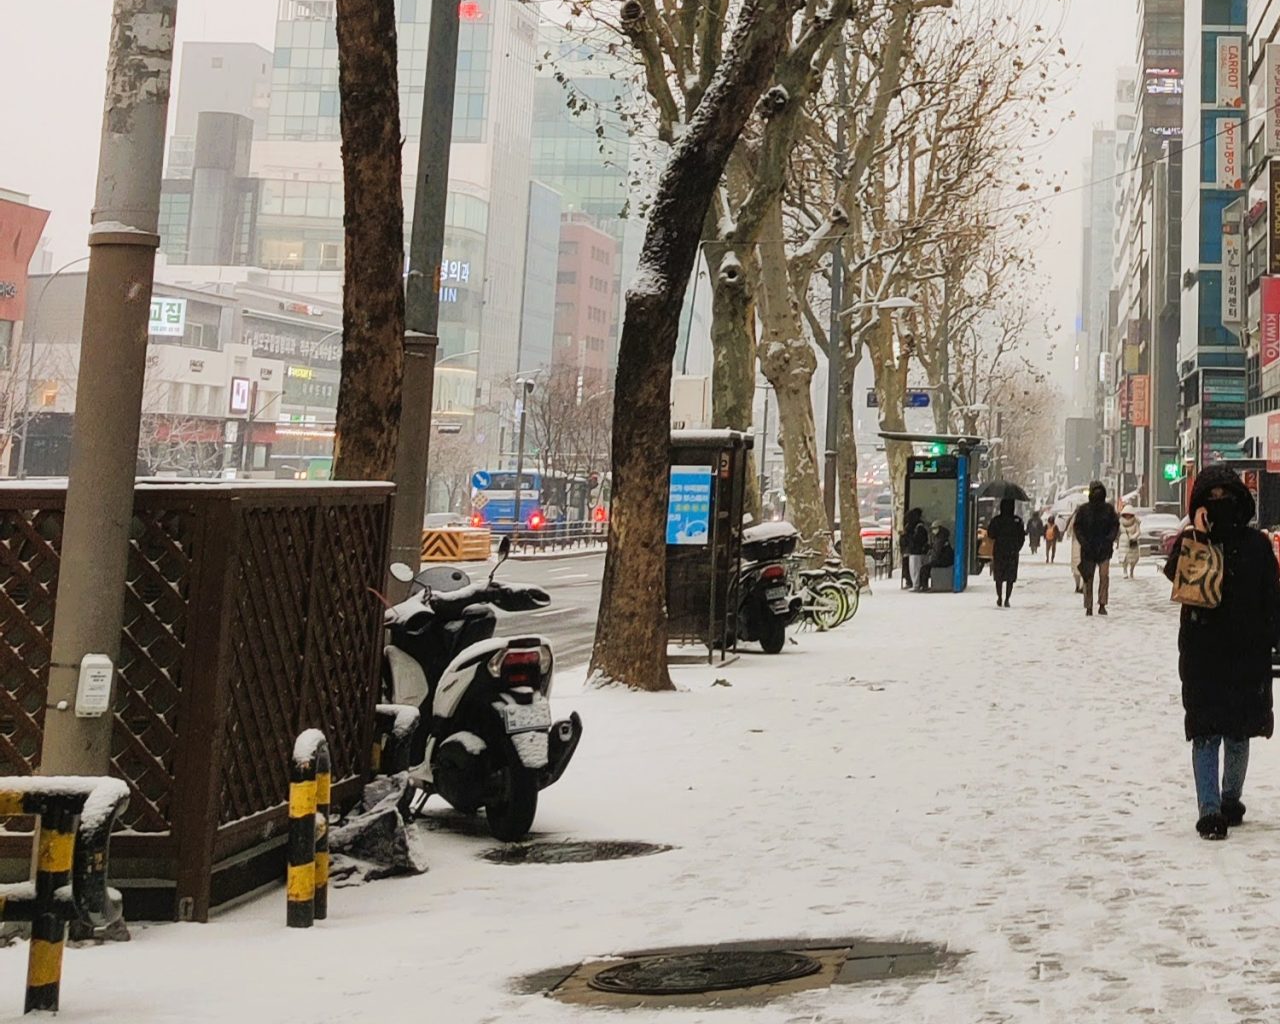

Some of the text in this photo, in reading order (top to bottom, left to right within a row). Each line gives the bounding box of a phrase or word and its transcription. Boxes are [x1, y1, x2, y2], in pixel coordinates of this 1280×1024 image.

[1227, 45, 1239, 89] CARROT
[1227, 275, 1237, 318] 심리센터
[1266, 313, 1280, 358] KIWIYO
